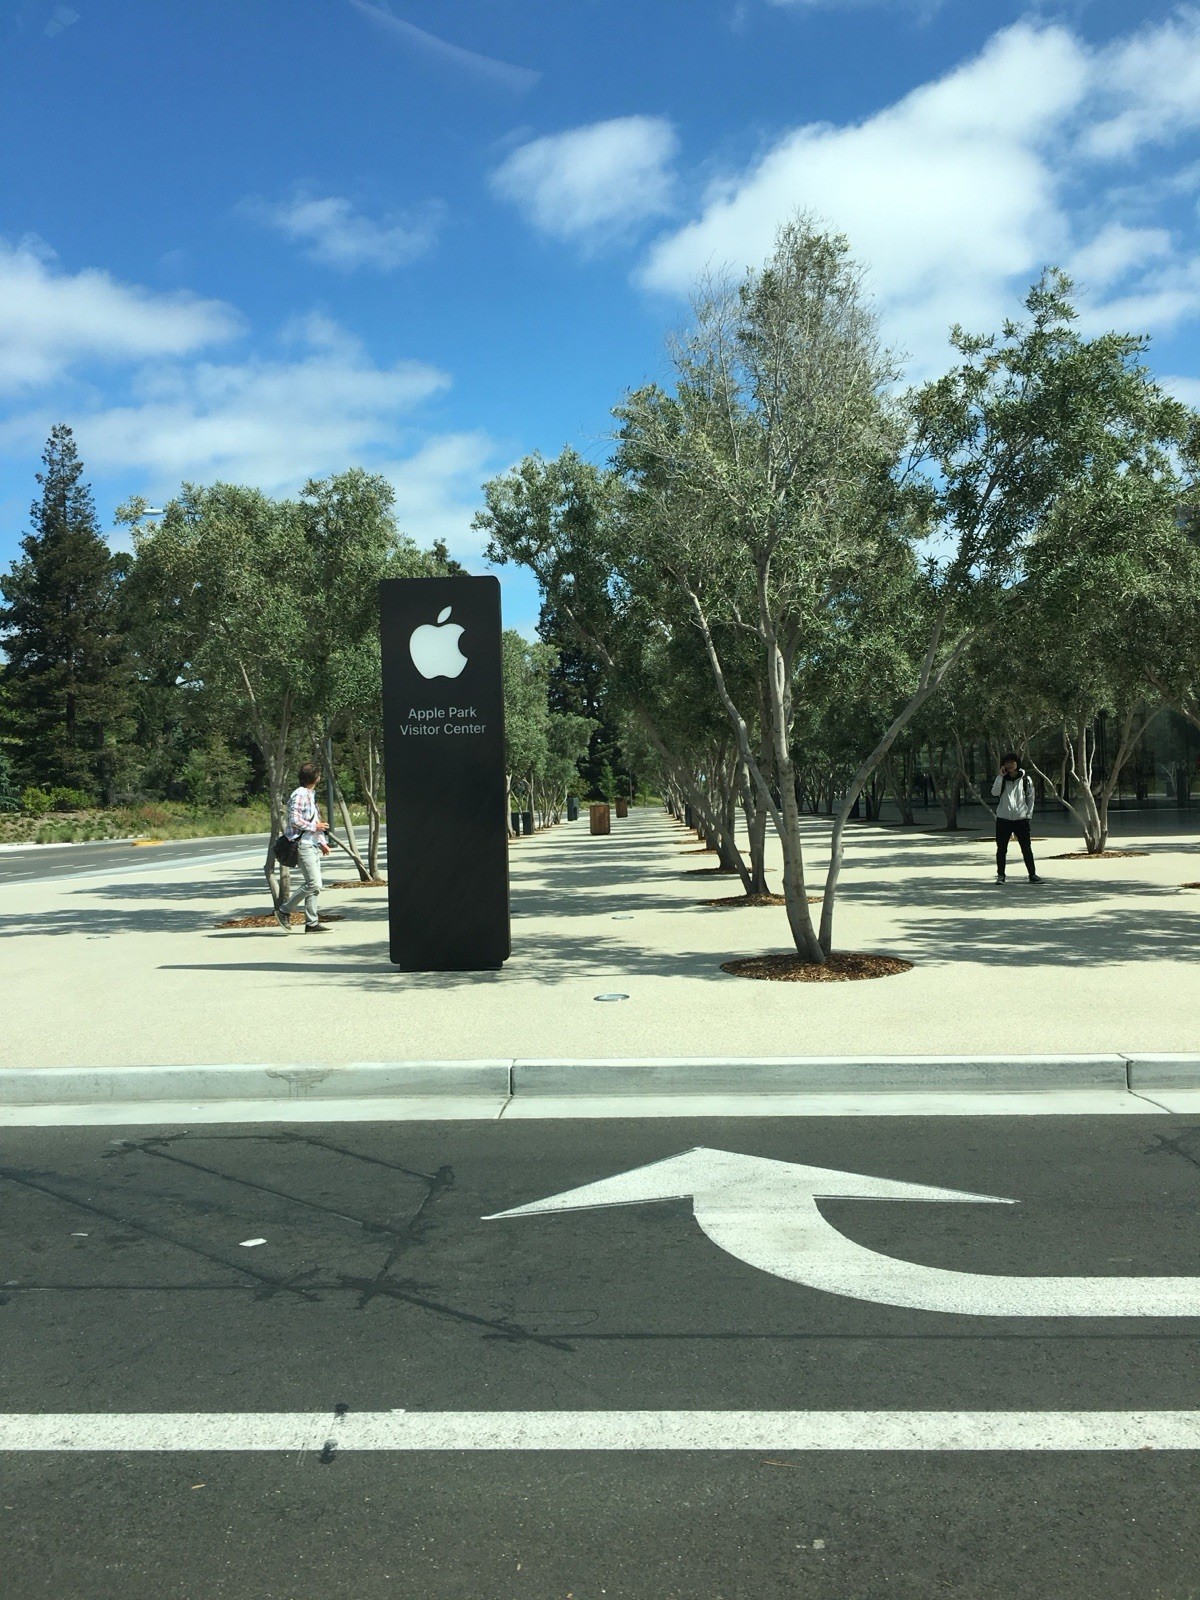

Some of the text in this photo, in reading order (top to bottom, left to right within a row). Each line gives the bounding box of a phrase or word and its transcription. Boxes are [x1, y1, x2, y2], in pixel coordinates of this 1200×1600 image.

[408, 706, 477, 721] Apple Park
[400, 723, 486, 736] Visitor Center
